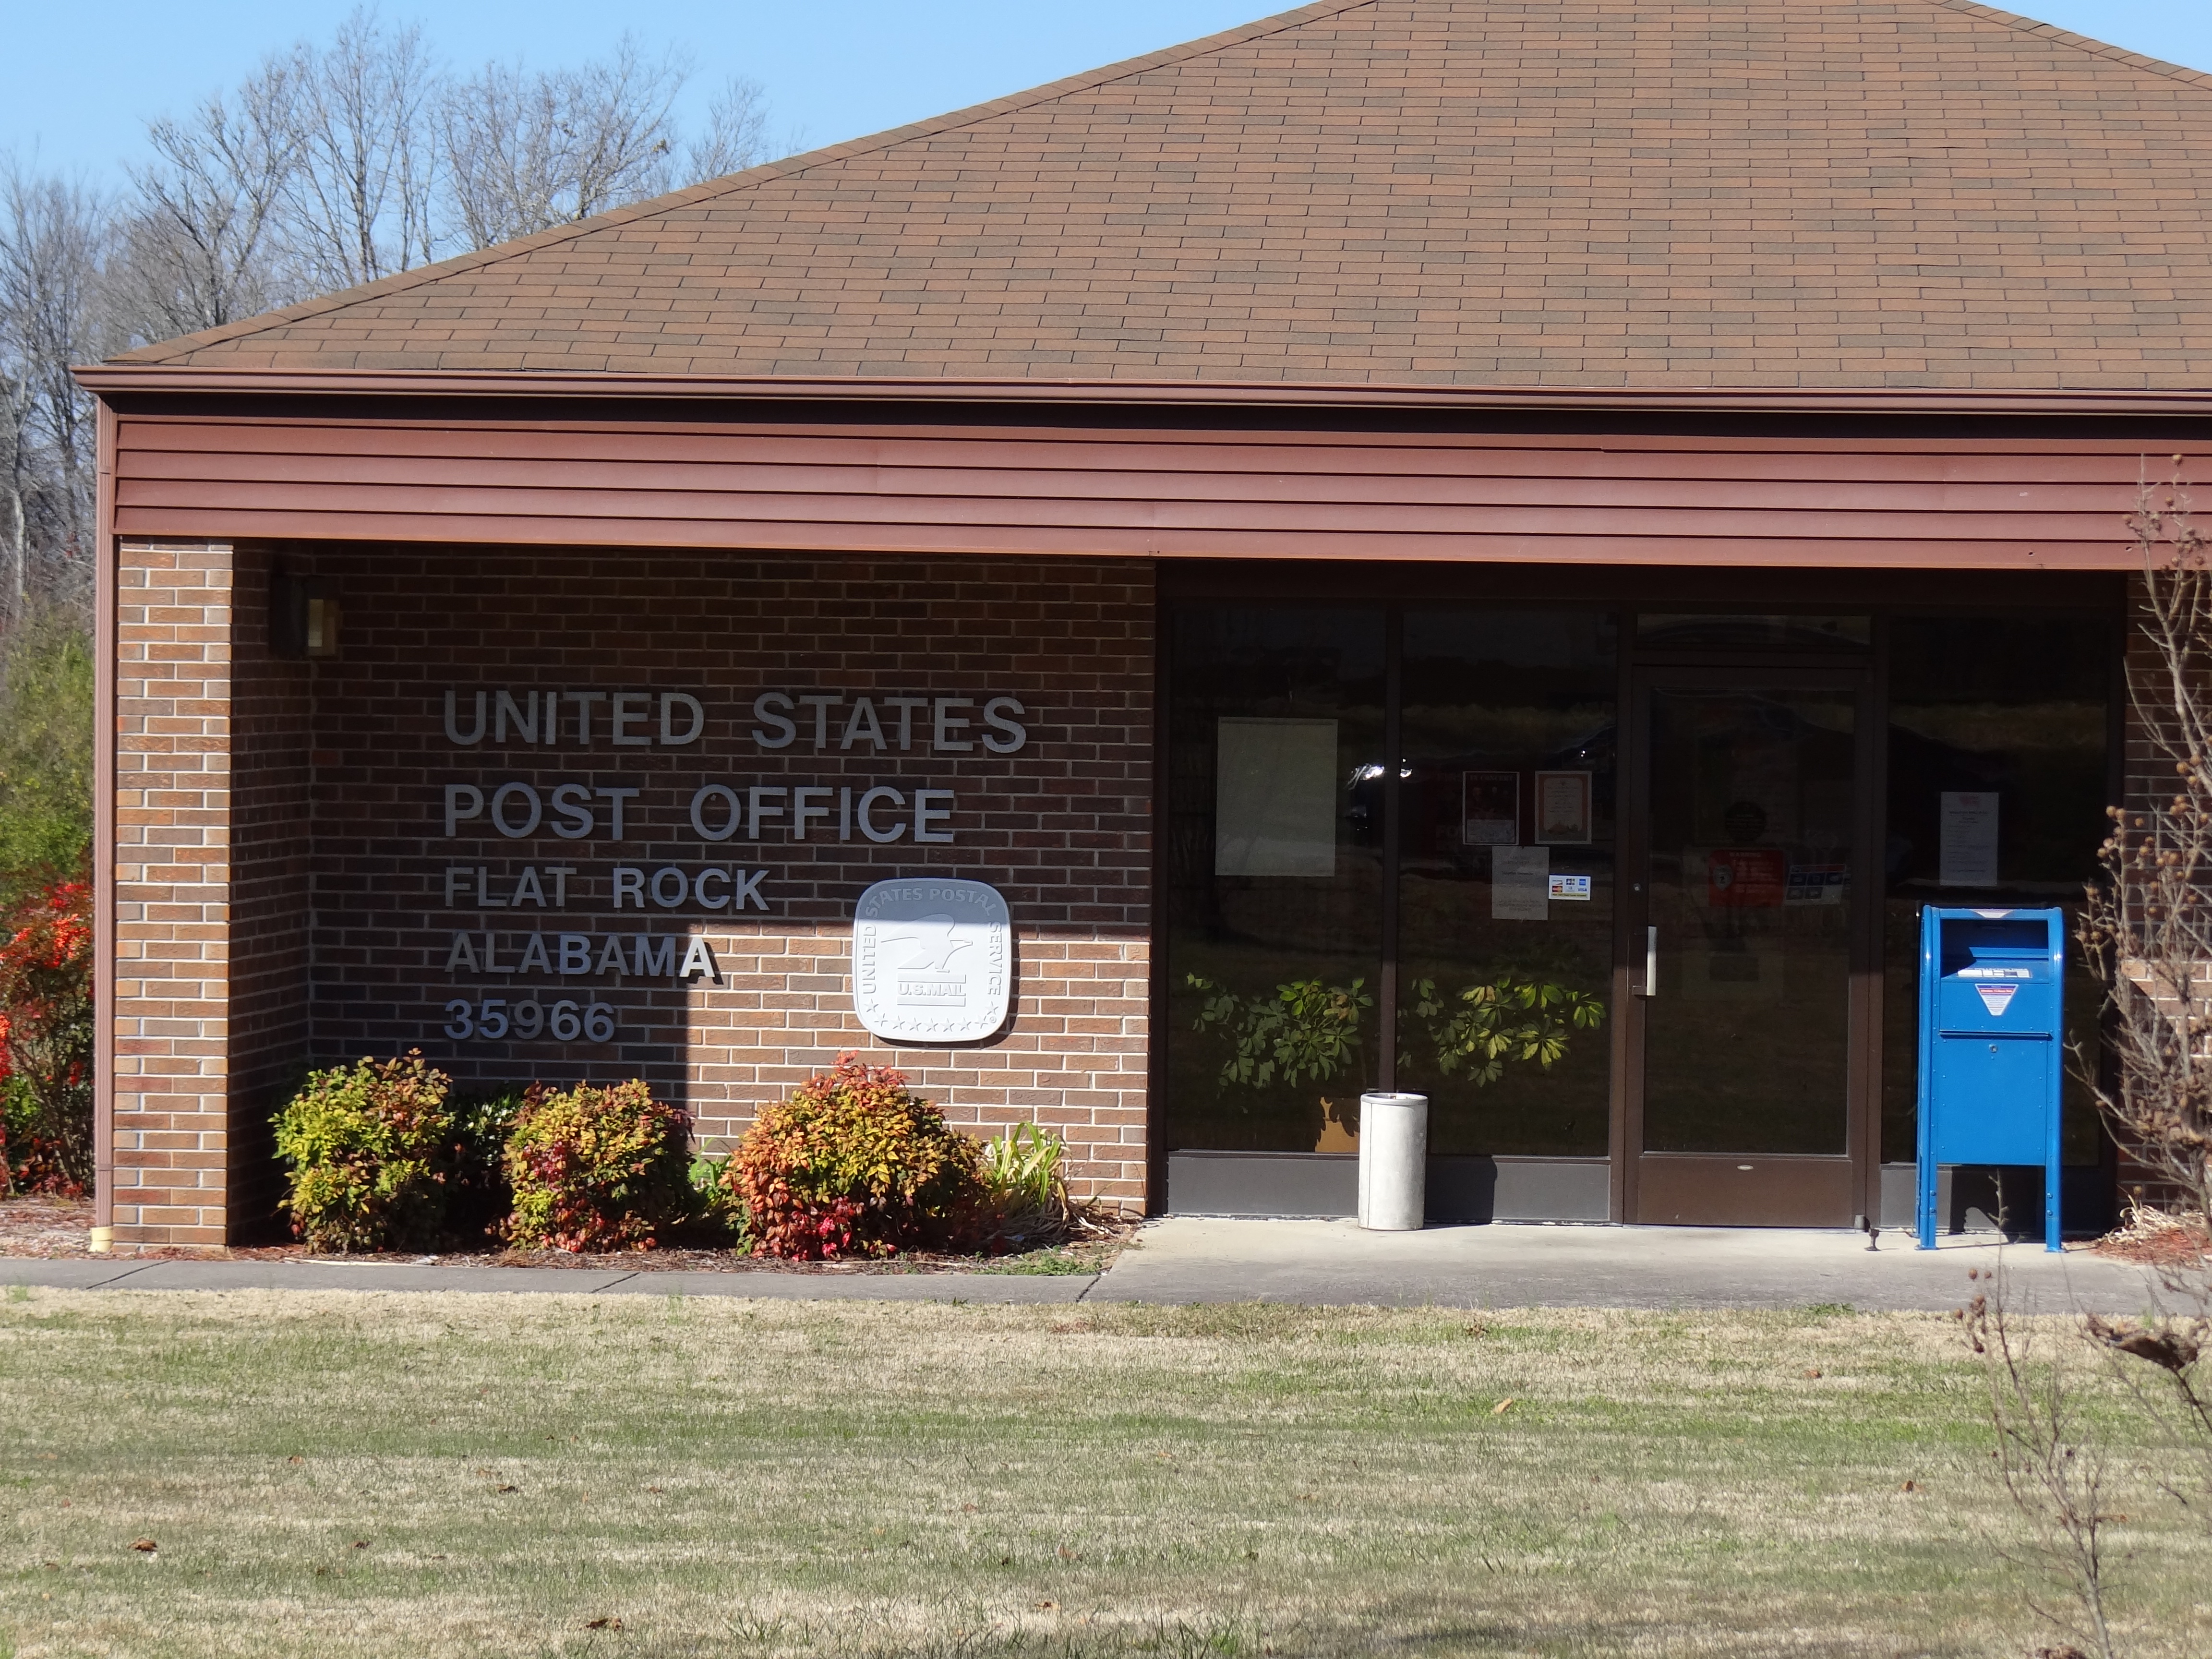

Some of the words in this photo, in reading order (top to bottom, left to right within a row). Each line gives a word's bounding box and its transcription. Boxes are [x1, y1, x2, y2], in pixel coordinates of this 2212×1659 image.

[444, 690, 705, 746] UNITED
[752, 692, 1027, 754] STATES
[445, 781, 640, 842] POST
[690, 783, 954, 843] OFFICE
[445, 866, 577, 907] FLAT
[613, 867, 770, 911] ROCK
[865, 887, 923, 918] STATES
[928, 888, 997, 917] POSTAL
[444, 931, 715, 978] ALABAMA
[862, 924, 877, 994] UNITED
[987, 921, 1003, 996] SERVICE
[444, 998, 615, 1043] 35966
